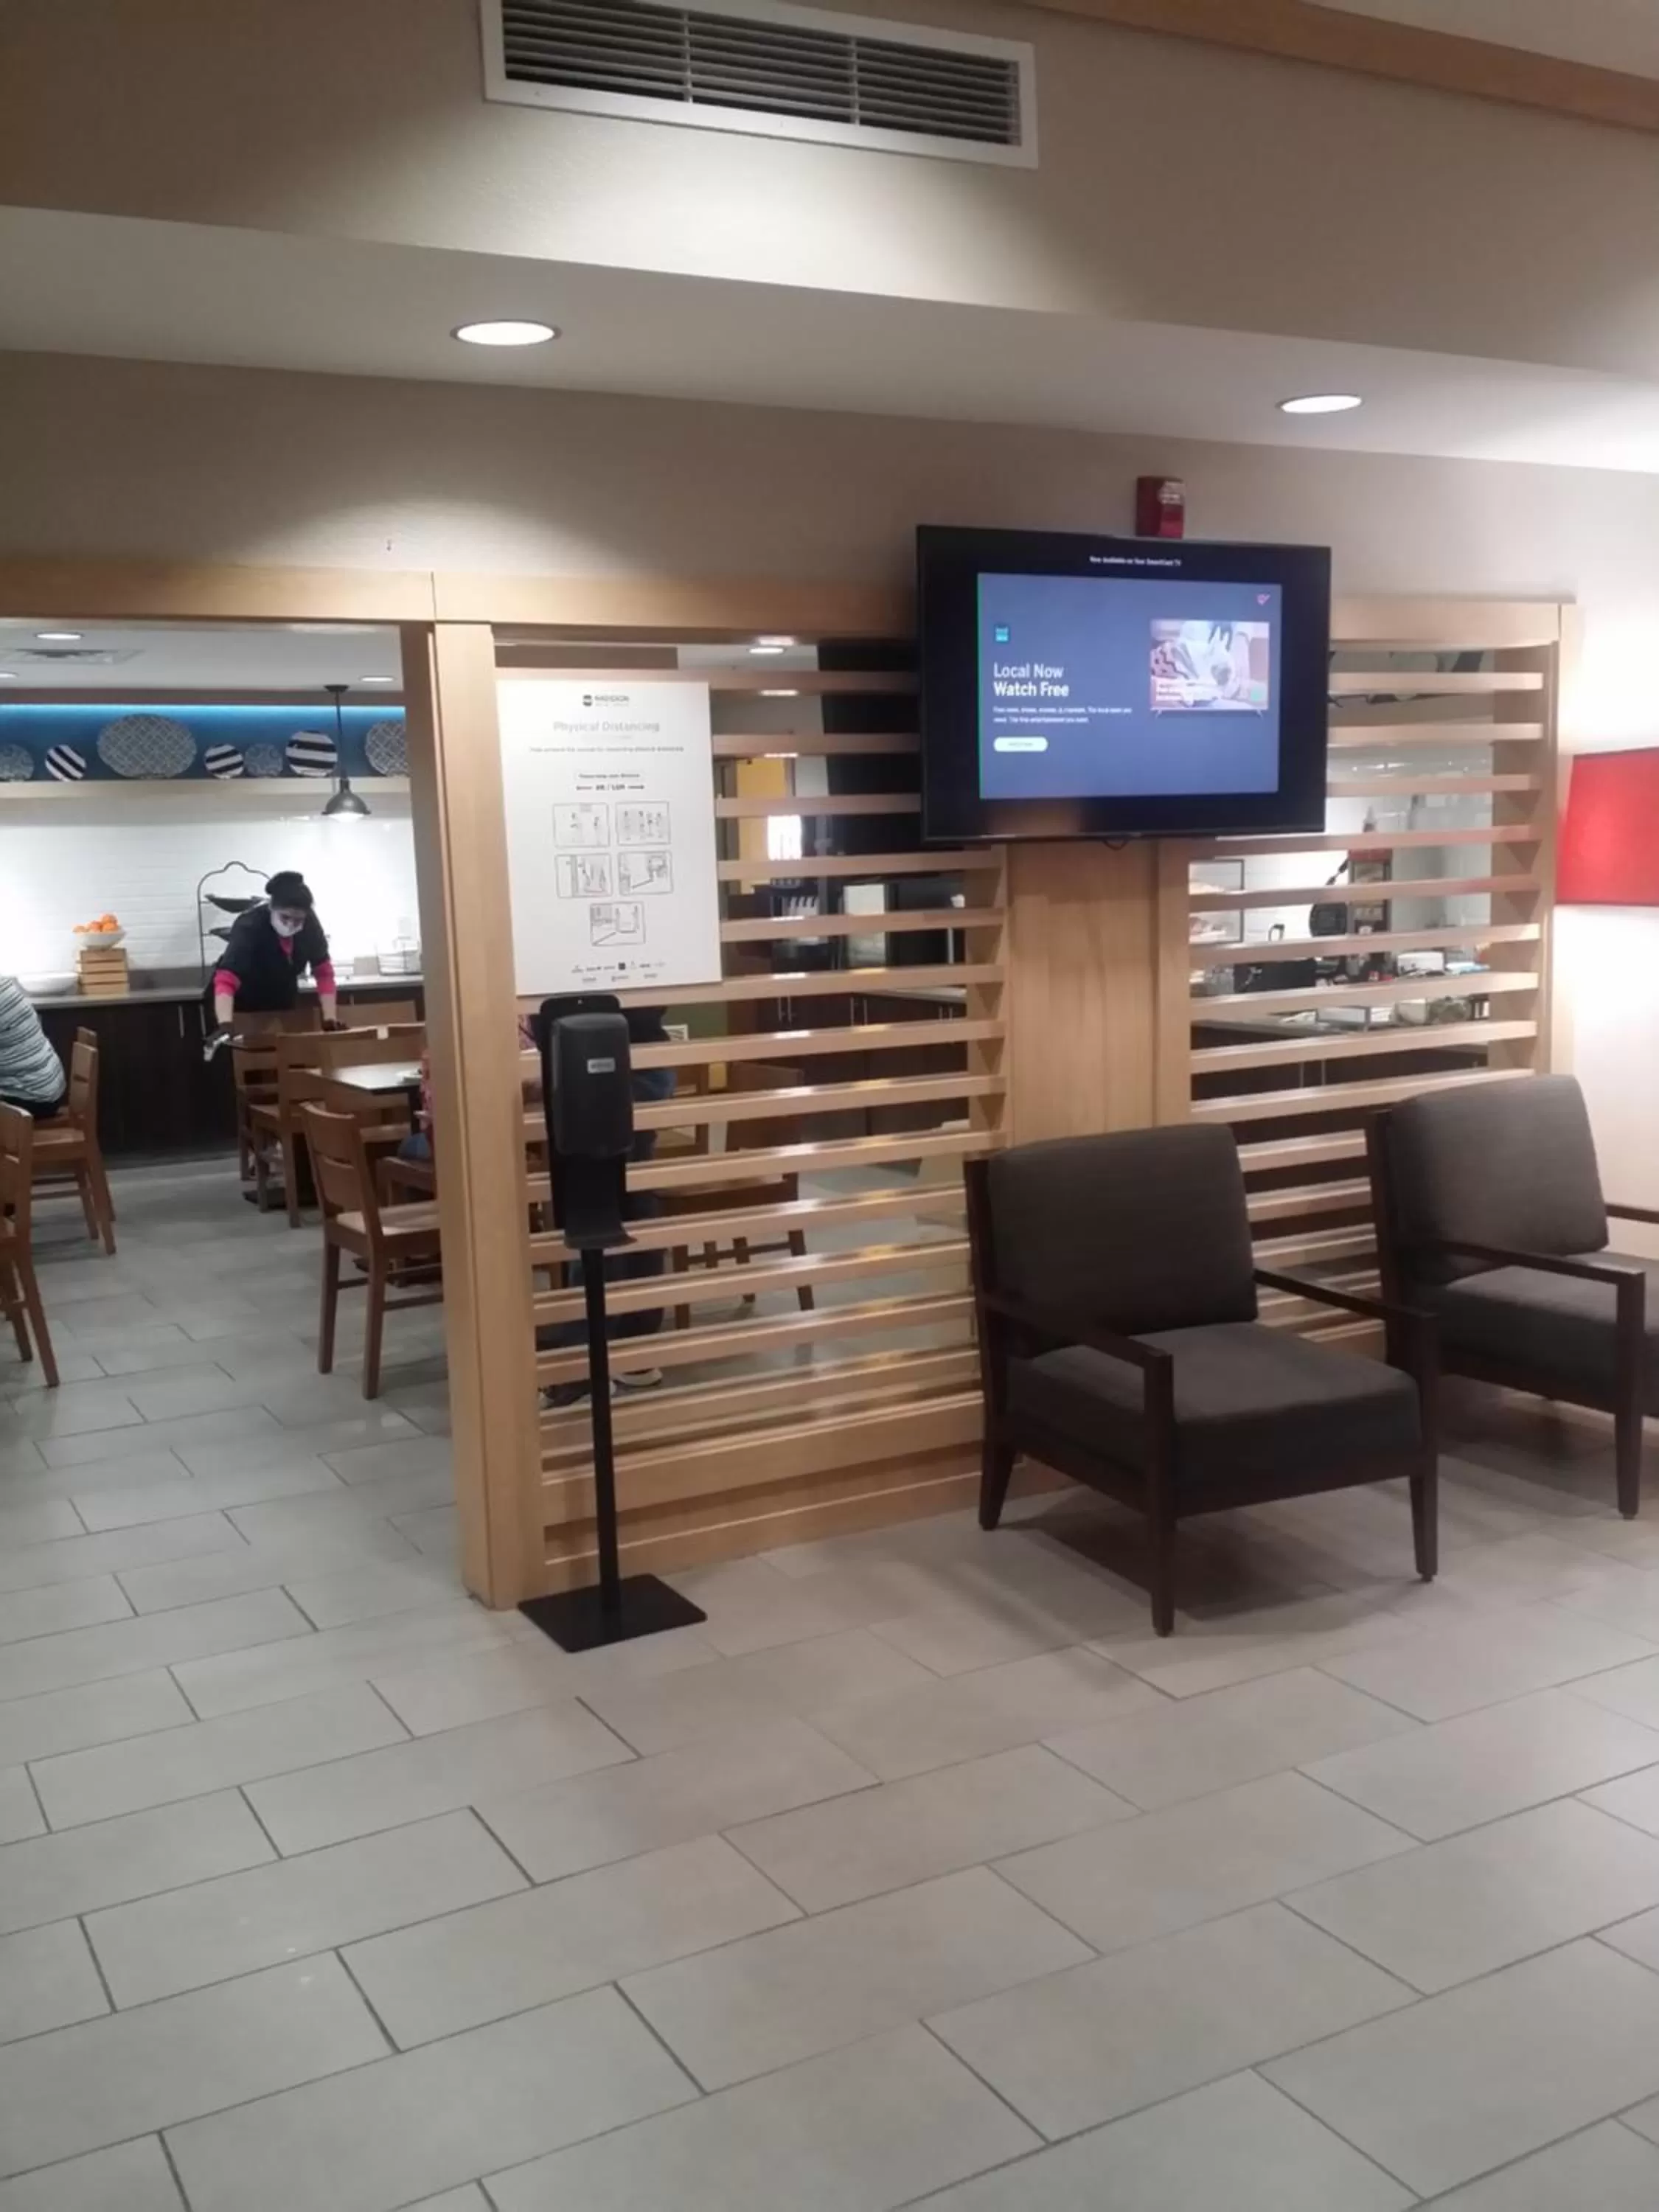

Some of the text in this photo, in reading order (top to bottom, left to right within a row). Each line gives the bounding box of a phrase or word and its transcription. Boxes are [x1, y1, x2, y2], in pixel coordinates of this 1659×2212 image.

[993, 661, 1064, 678] Local Now
[993, 681, 1069, 697] Watch Free
